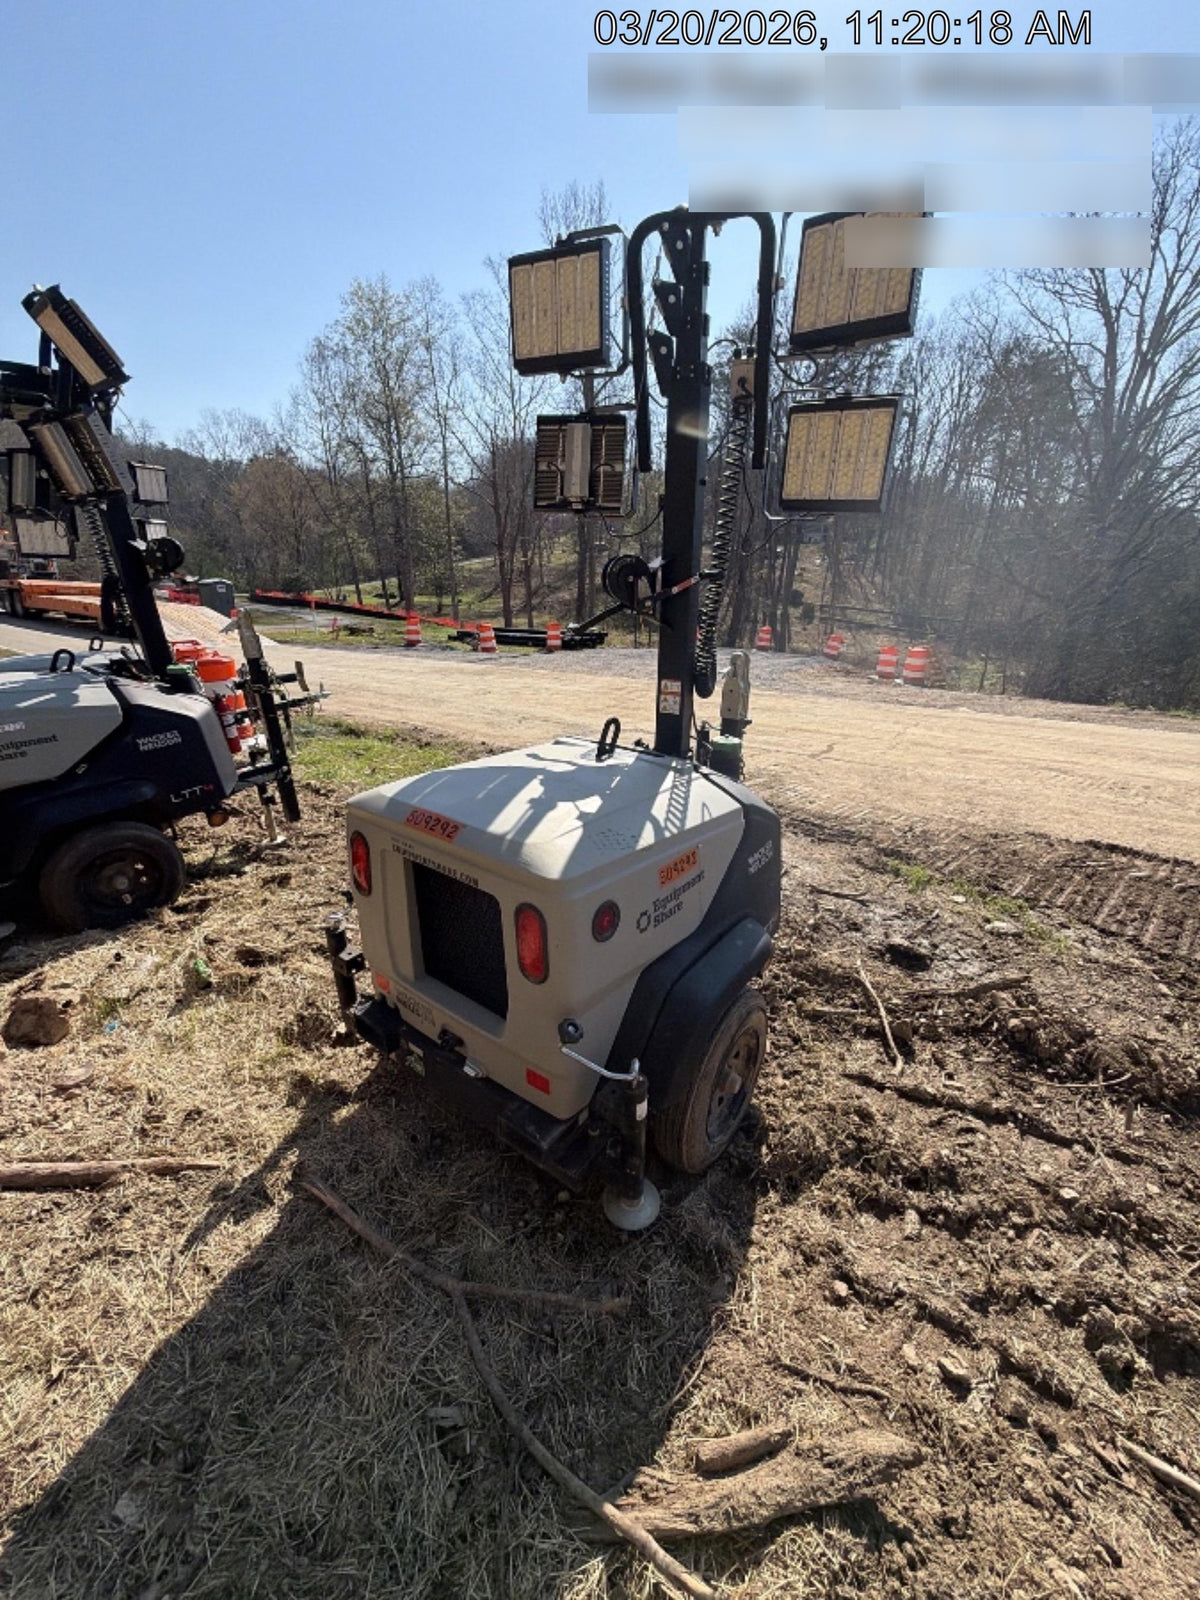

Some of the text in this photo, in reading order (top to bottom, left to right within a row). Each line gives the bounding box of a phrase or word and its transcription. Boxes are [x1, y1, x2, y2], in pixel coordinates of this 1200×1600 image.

[406, 809, 460, 839] 509292
[652, 869, 705, 913] Equipment
[653, 900, 684, 929] Share
